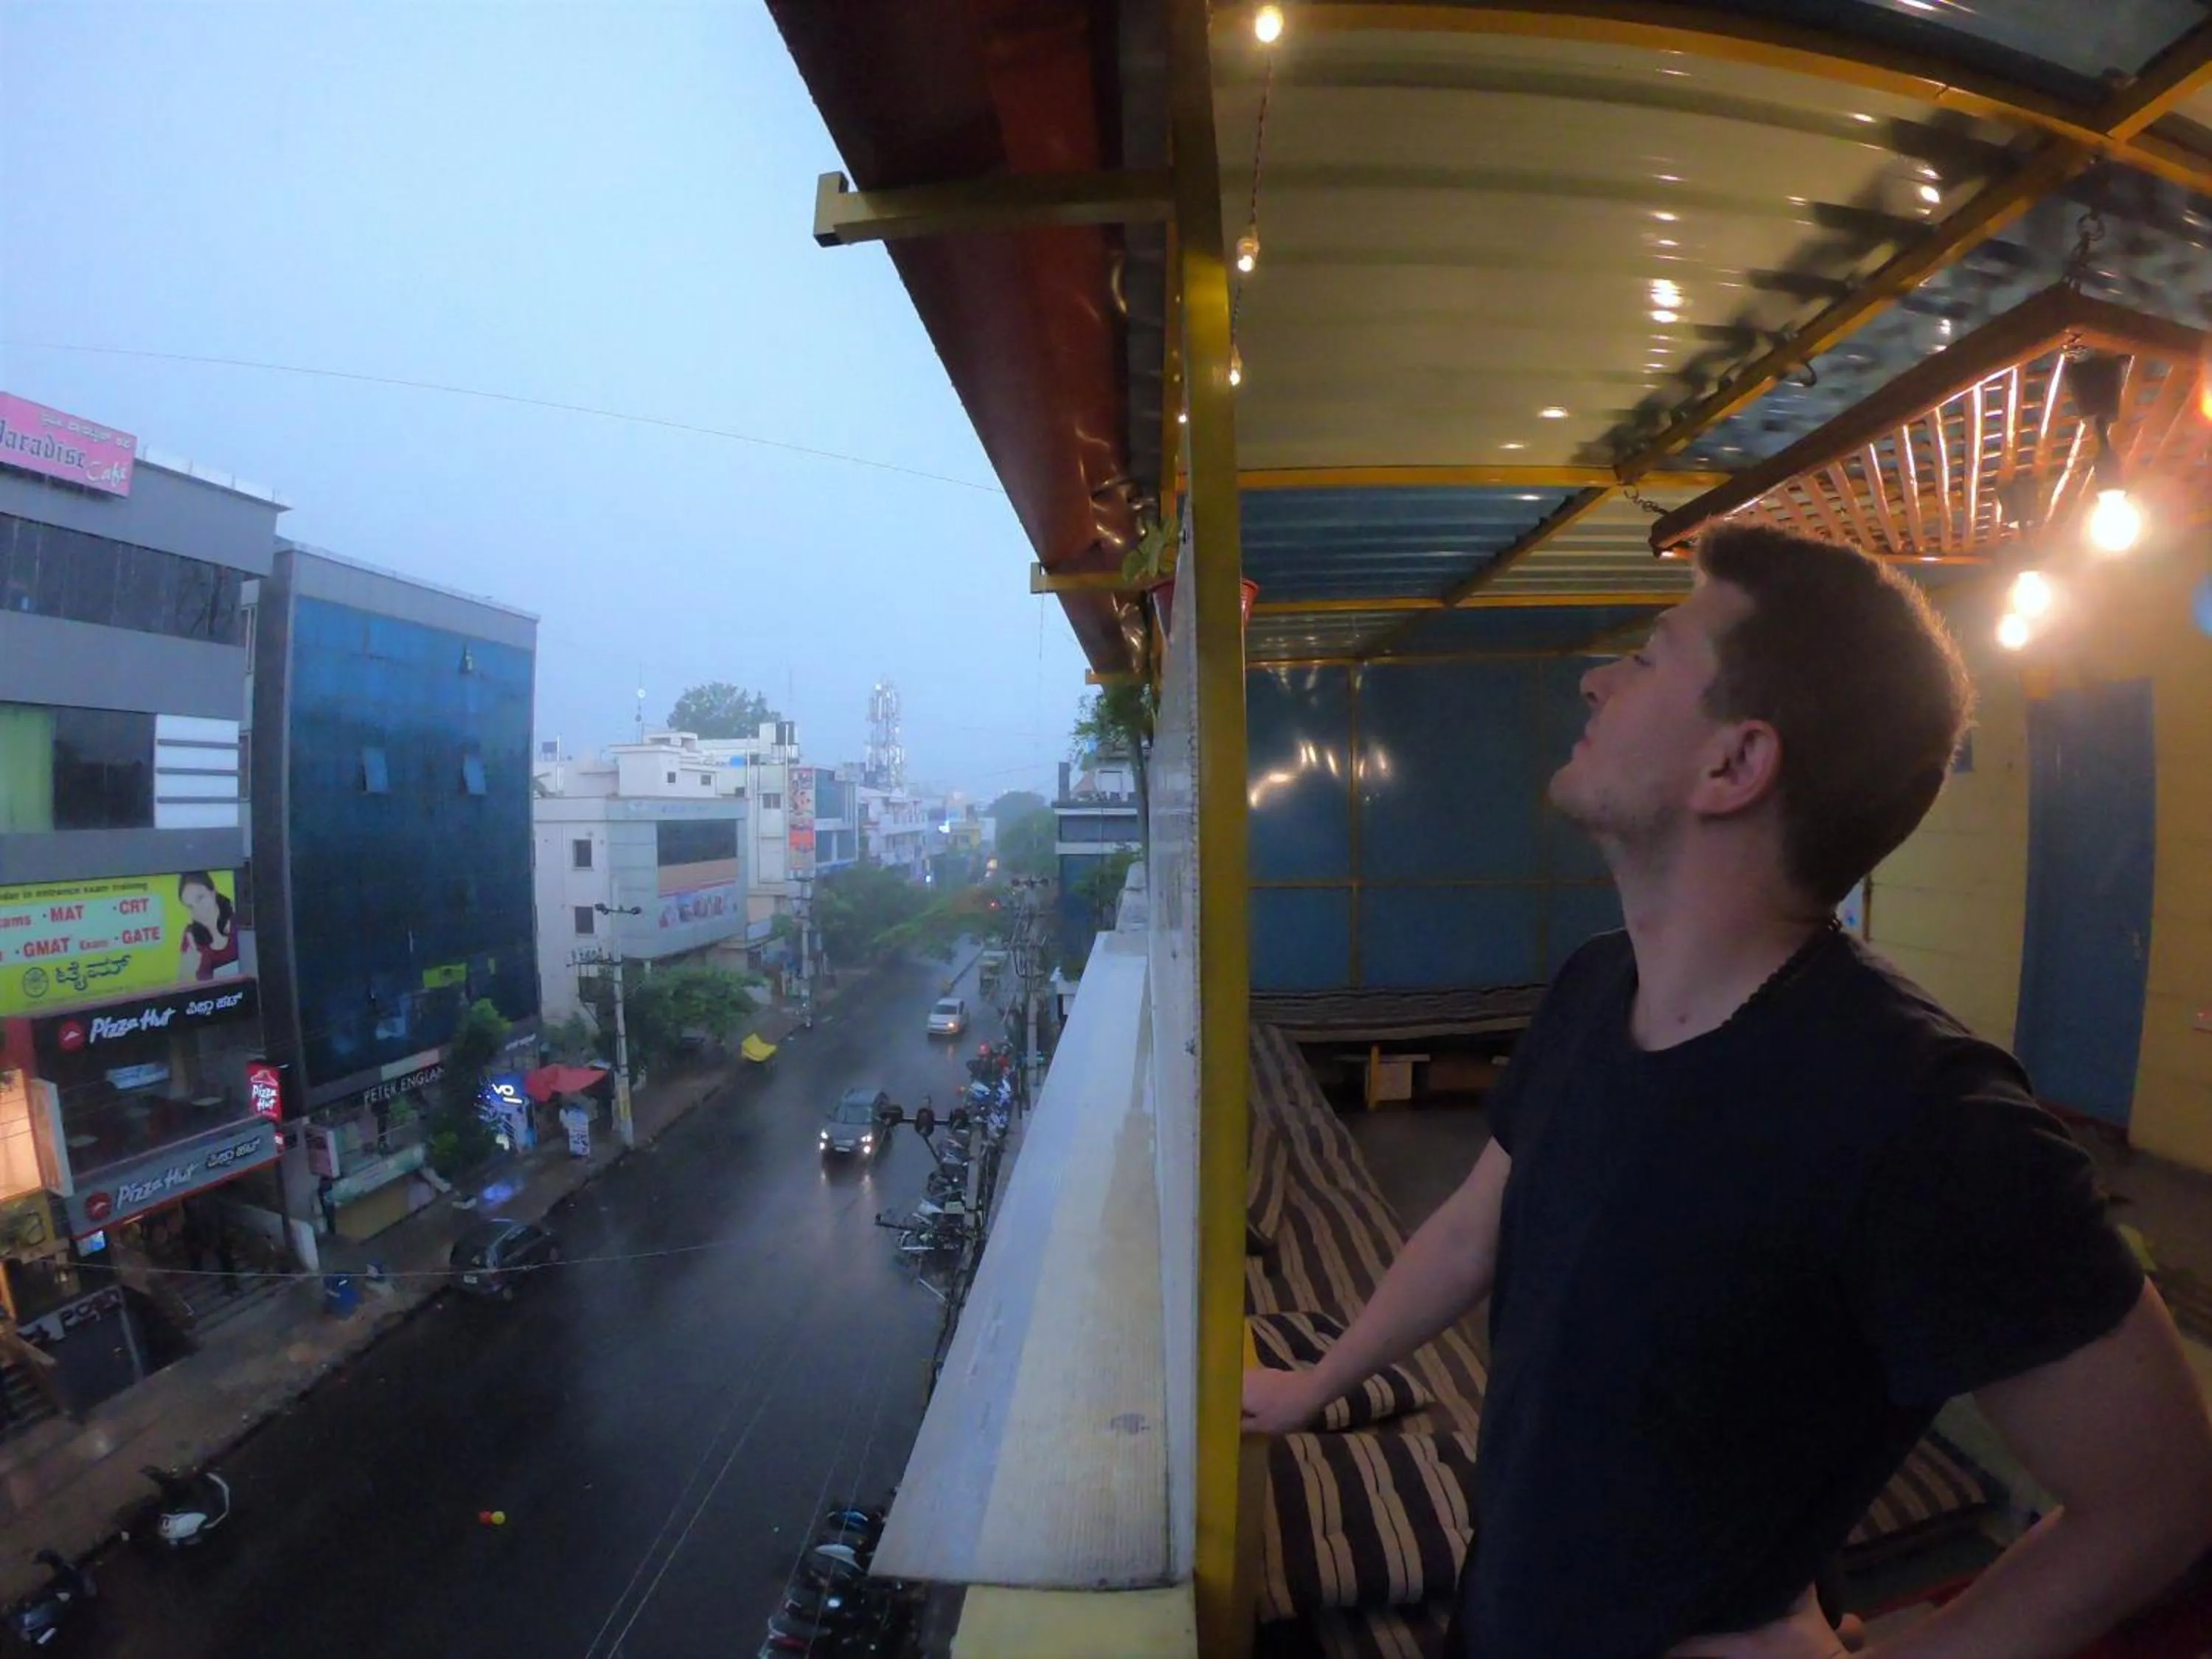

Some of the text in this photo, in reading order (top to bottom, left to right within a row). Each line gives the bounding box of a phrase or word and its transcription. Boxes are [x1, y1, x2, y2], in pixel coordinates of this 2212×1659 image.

[49, 905, 85, 922] MAT
[23, 937, 70, 958] GMAT
[122, 926, 161, 945] GATE
[88, 1007, 176, 1043] Pizza Hut
[251, 1085, 278, 1099] Pizza
[257, 1097, 277, 1112] Hut
[116, 1162, 200, 1210] Pizza Hut
